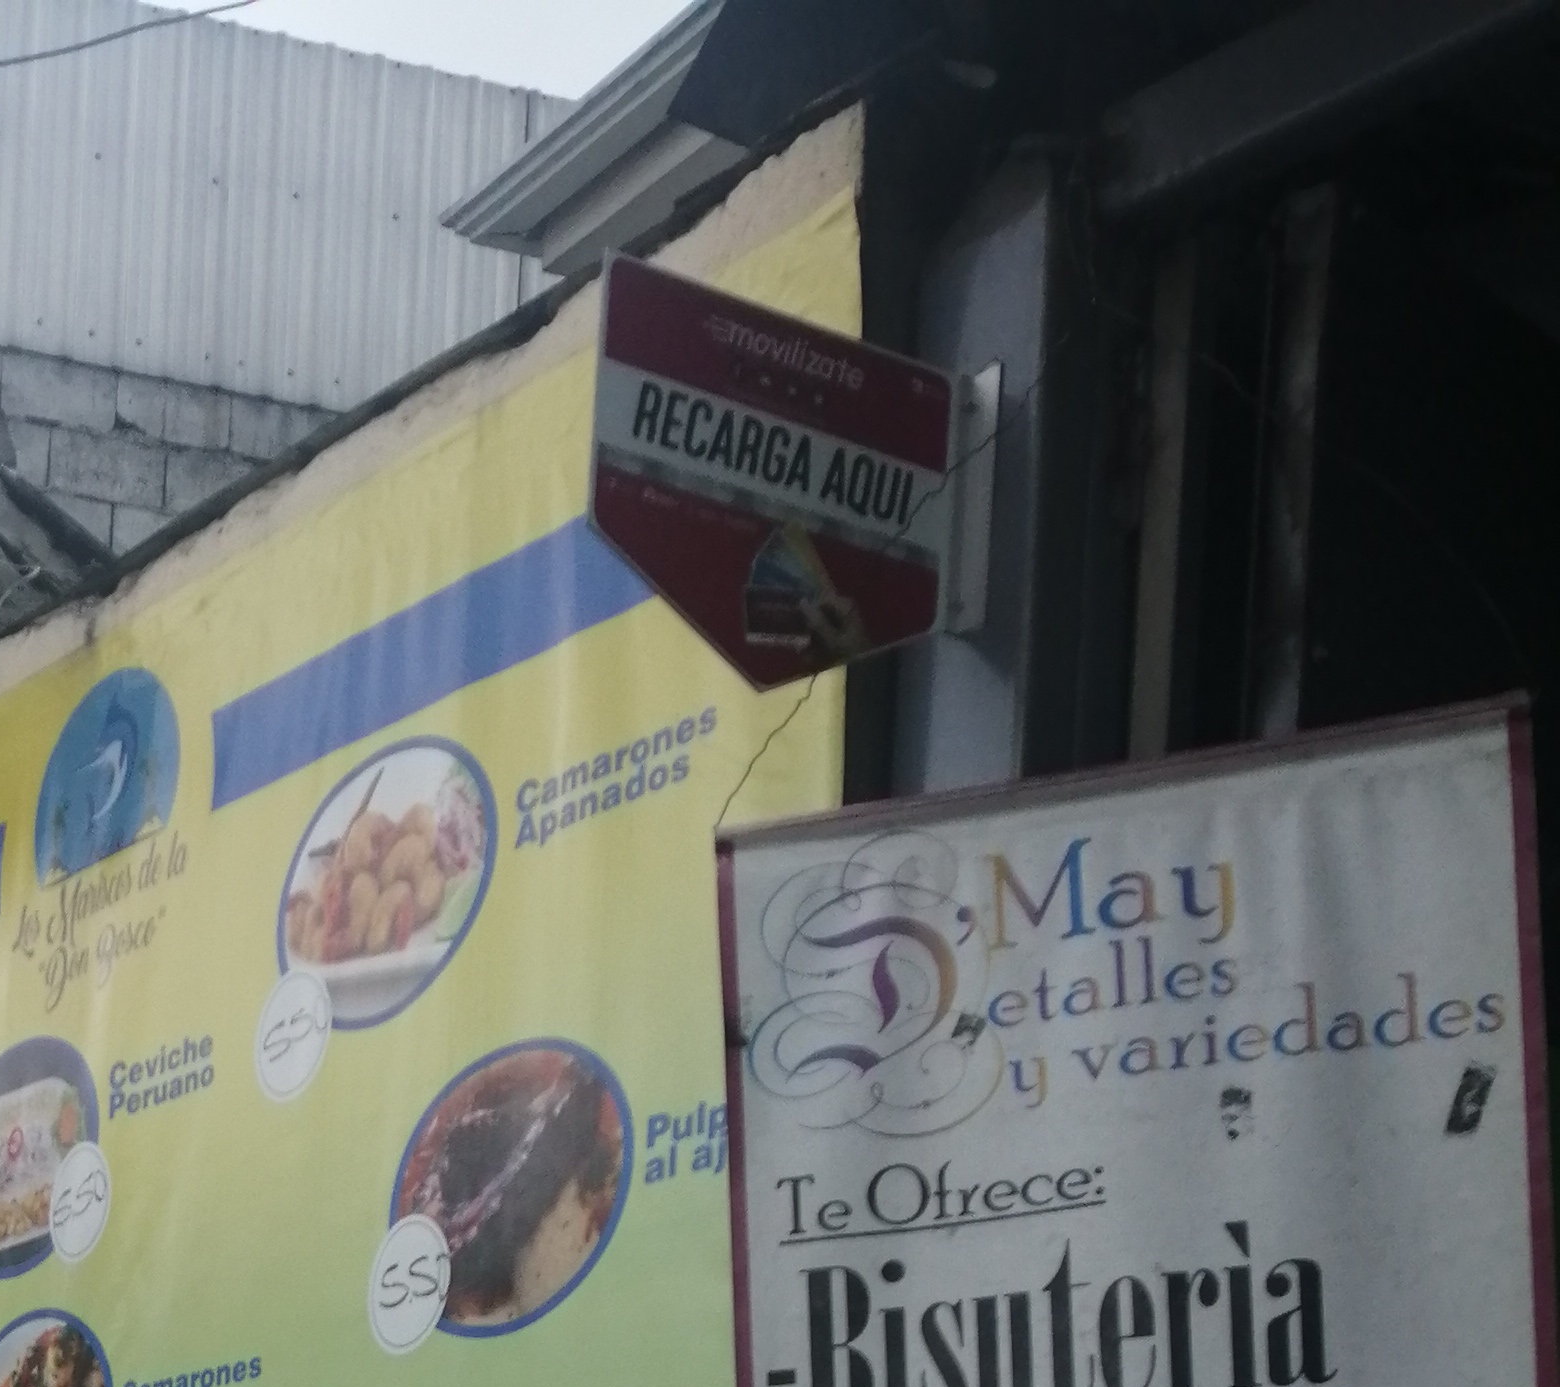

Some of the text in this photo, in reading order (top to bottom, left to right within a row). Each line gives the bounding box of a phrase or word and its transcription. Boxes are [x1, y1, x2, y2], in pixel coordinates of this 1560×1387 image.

[632, 380, 810, 492] RECARGA
[820, 447, 914, 525] AQUI
[515, 702, 718, 813] Camarones
[514, 753, 690, 848] Apanados
[108, 1034, 214, 1090] Ceviche
[1007, 972, 1506, 1110] y variedades
[108, 1064, 216, 1120] Peruano
[647, 1100, 728, 1148] Pulp
[645, 1143, 677, 1184] al
[775, 1172, 854, 1237] Te
